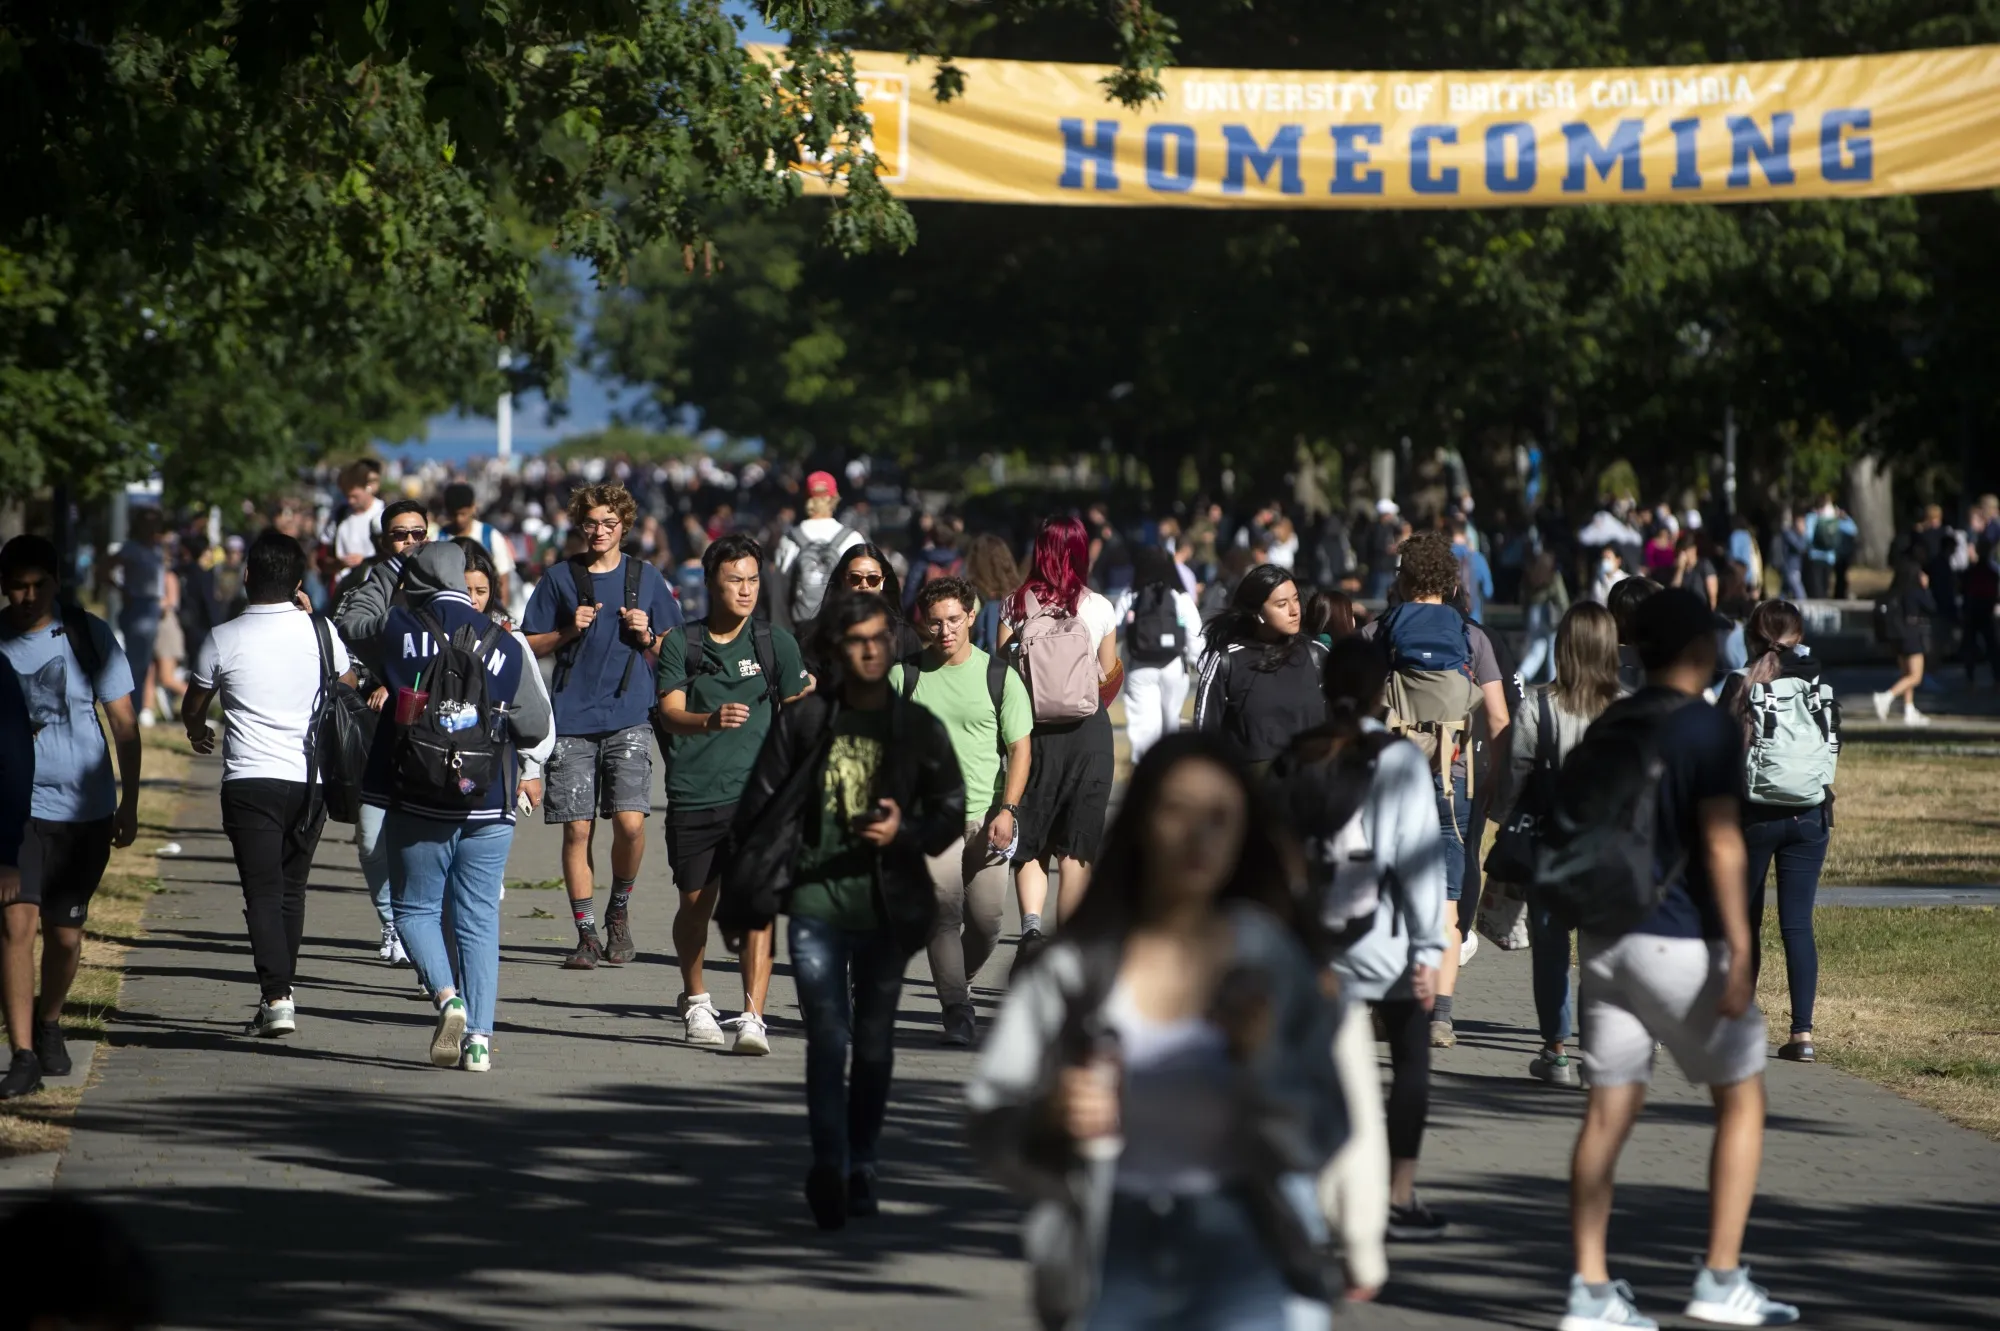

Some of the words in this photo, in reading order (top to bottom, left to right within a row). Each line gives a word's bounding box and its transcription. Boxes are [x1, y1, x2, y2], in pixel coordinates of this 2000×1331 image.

[1182, 80, 1379, 112] UNIVERSITY
[1394, 82, 1433, 111] OF
[1449, 81, 1576, 112] BRITISH
[1589, 73, 1755, 108] COLUMBIA
[1060, 109, 1872, 194] HOMECOMING
